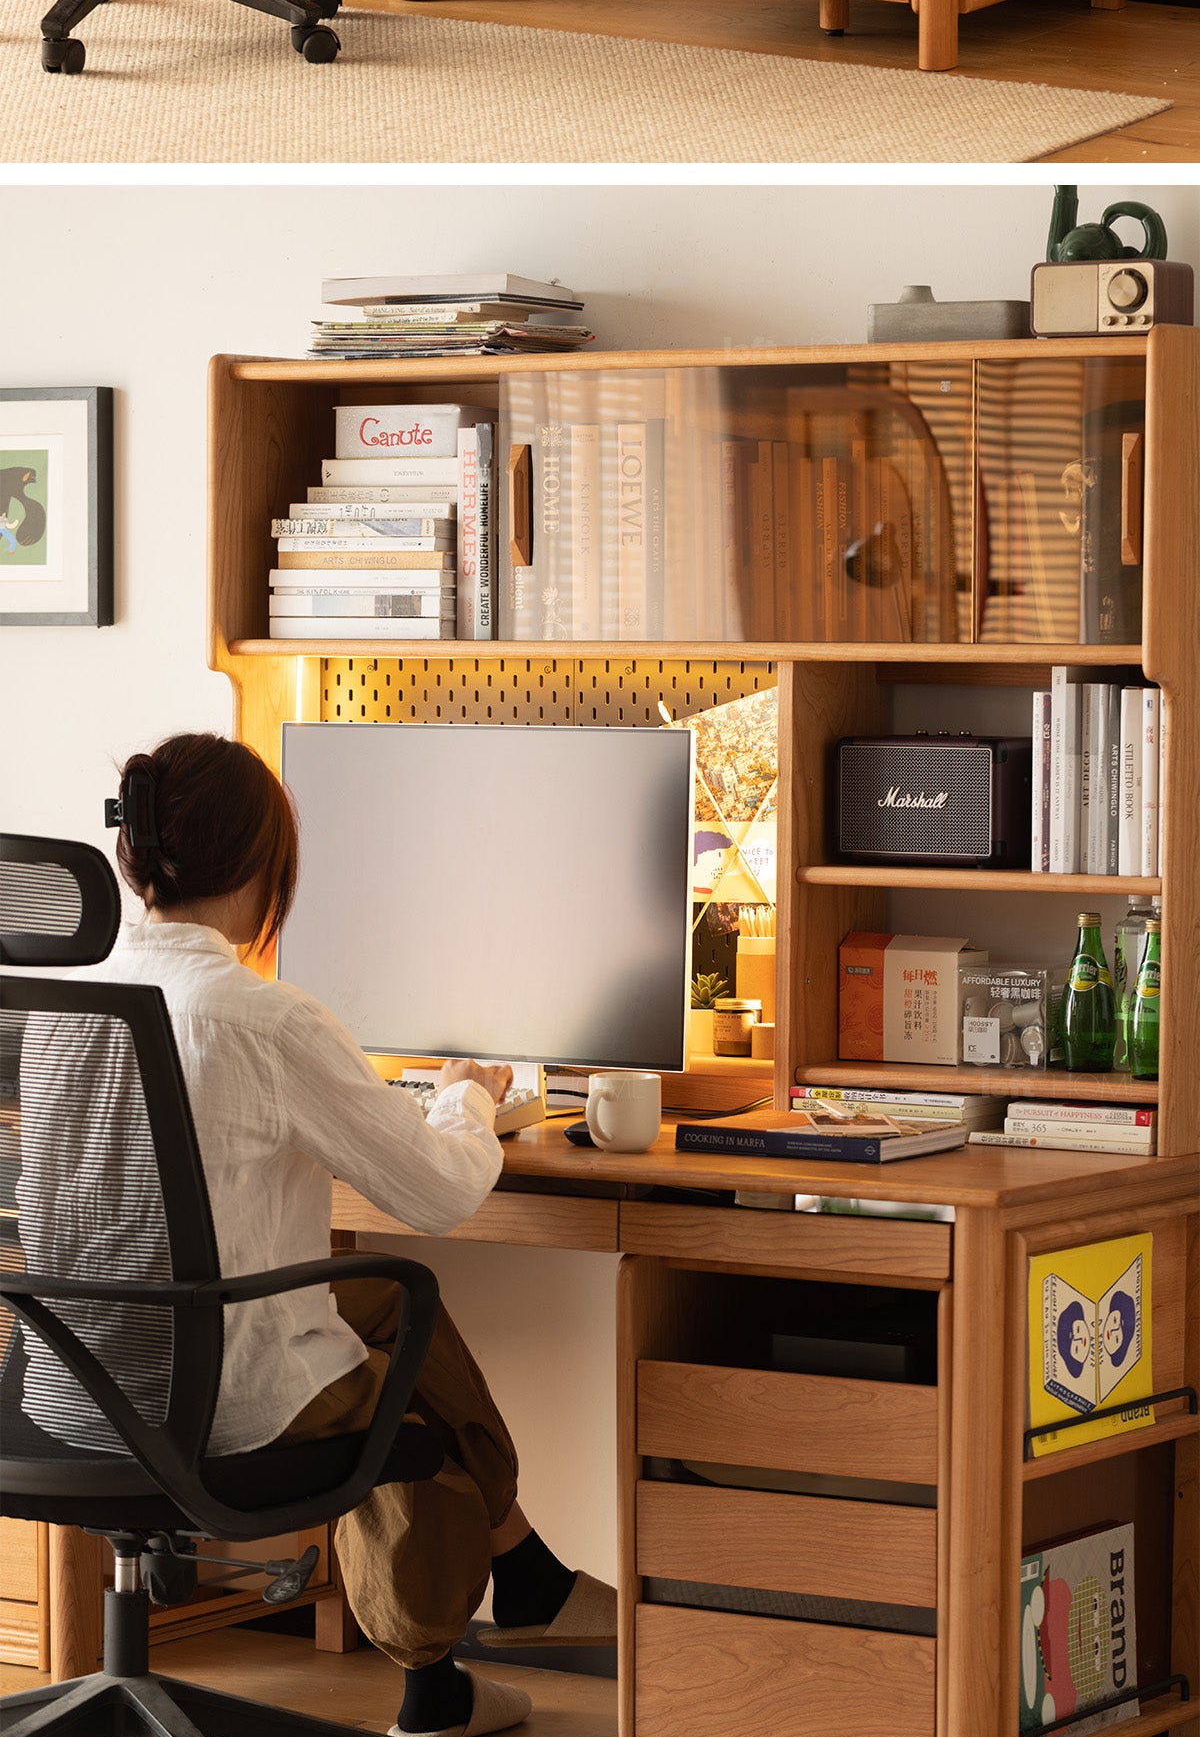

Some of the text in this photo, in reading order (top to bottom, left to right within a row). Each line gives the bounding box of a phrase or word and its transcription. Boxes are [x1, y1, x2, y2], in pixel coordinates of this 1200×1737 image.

[359, 417, 433, 447] Canute
[543, 455, 561, 534] HOME
[621, 440, 643, 547] LOEWE
[463, 448, 477, 577] HERMES
[479, 482, 490, 627] CREATE WONDERFUL HOMELIFE
[878, 786, 949, 810] Marshall
[1124, 793, 1134, 820] BOOK
[962, 976, 1041, 987] AFFORDABLE LUXURY
[1023, 1109, 1053, 1117] PURSUIT
[684, 1133, 766, 1148] COOKING IN MARFA
[1031, 1124, 1047, 1134] 365
